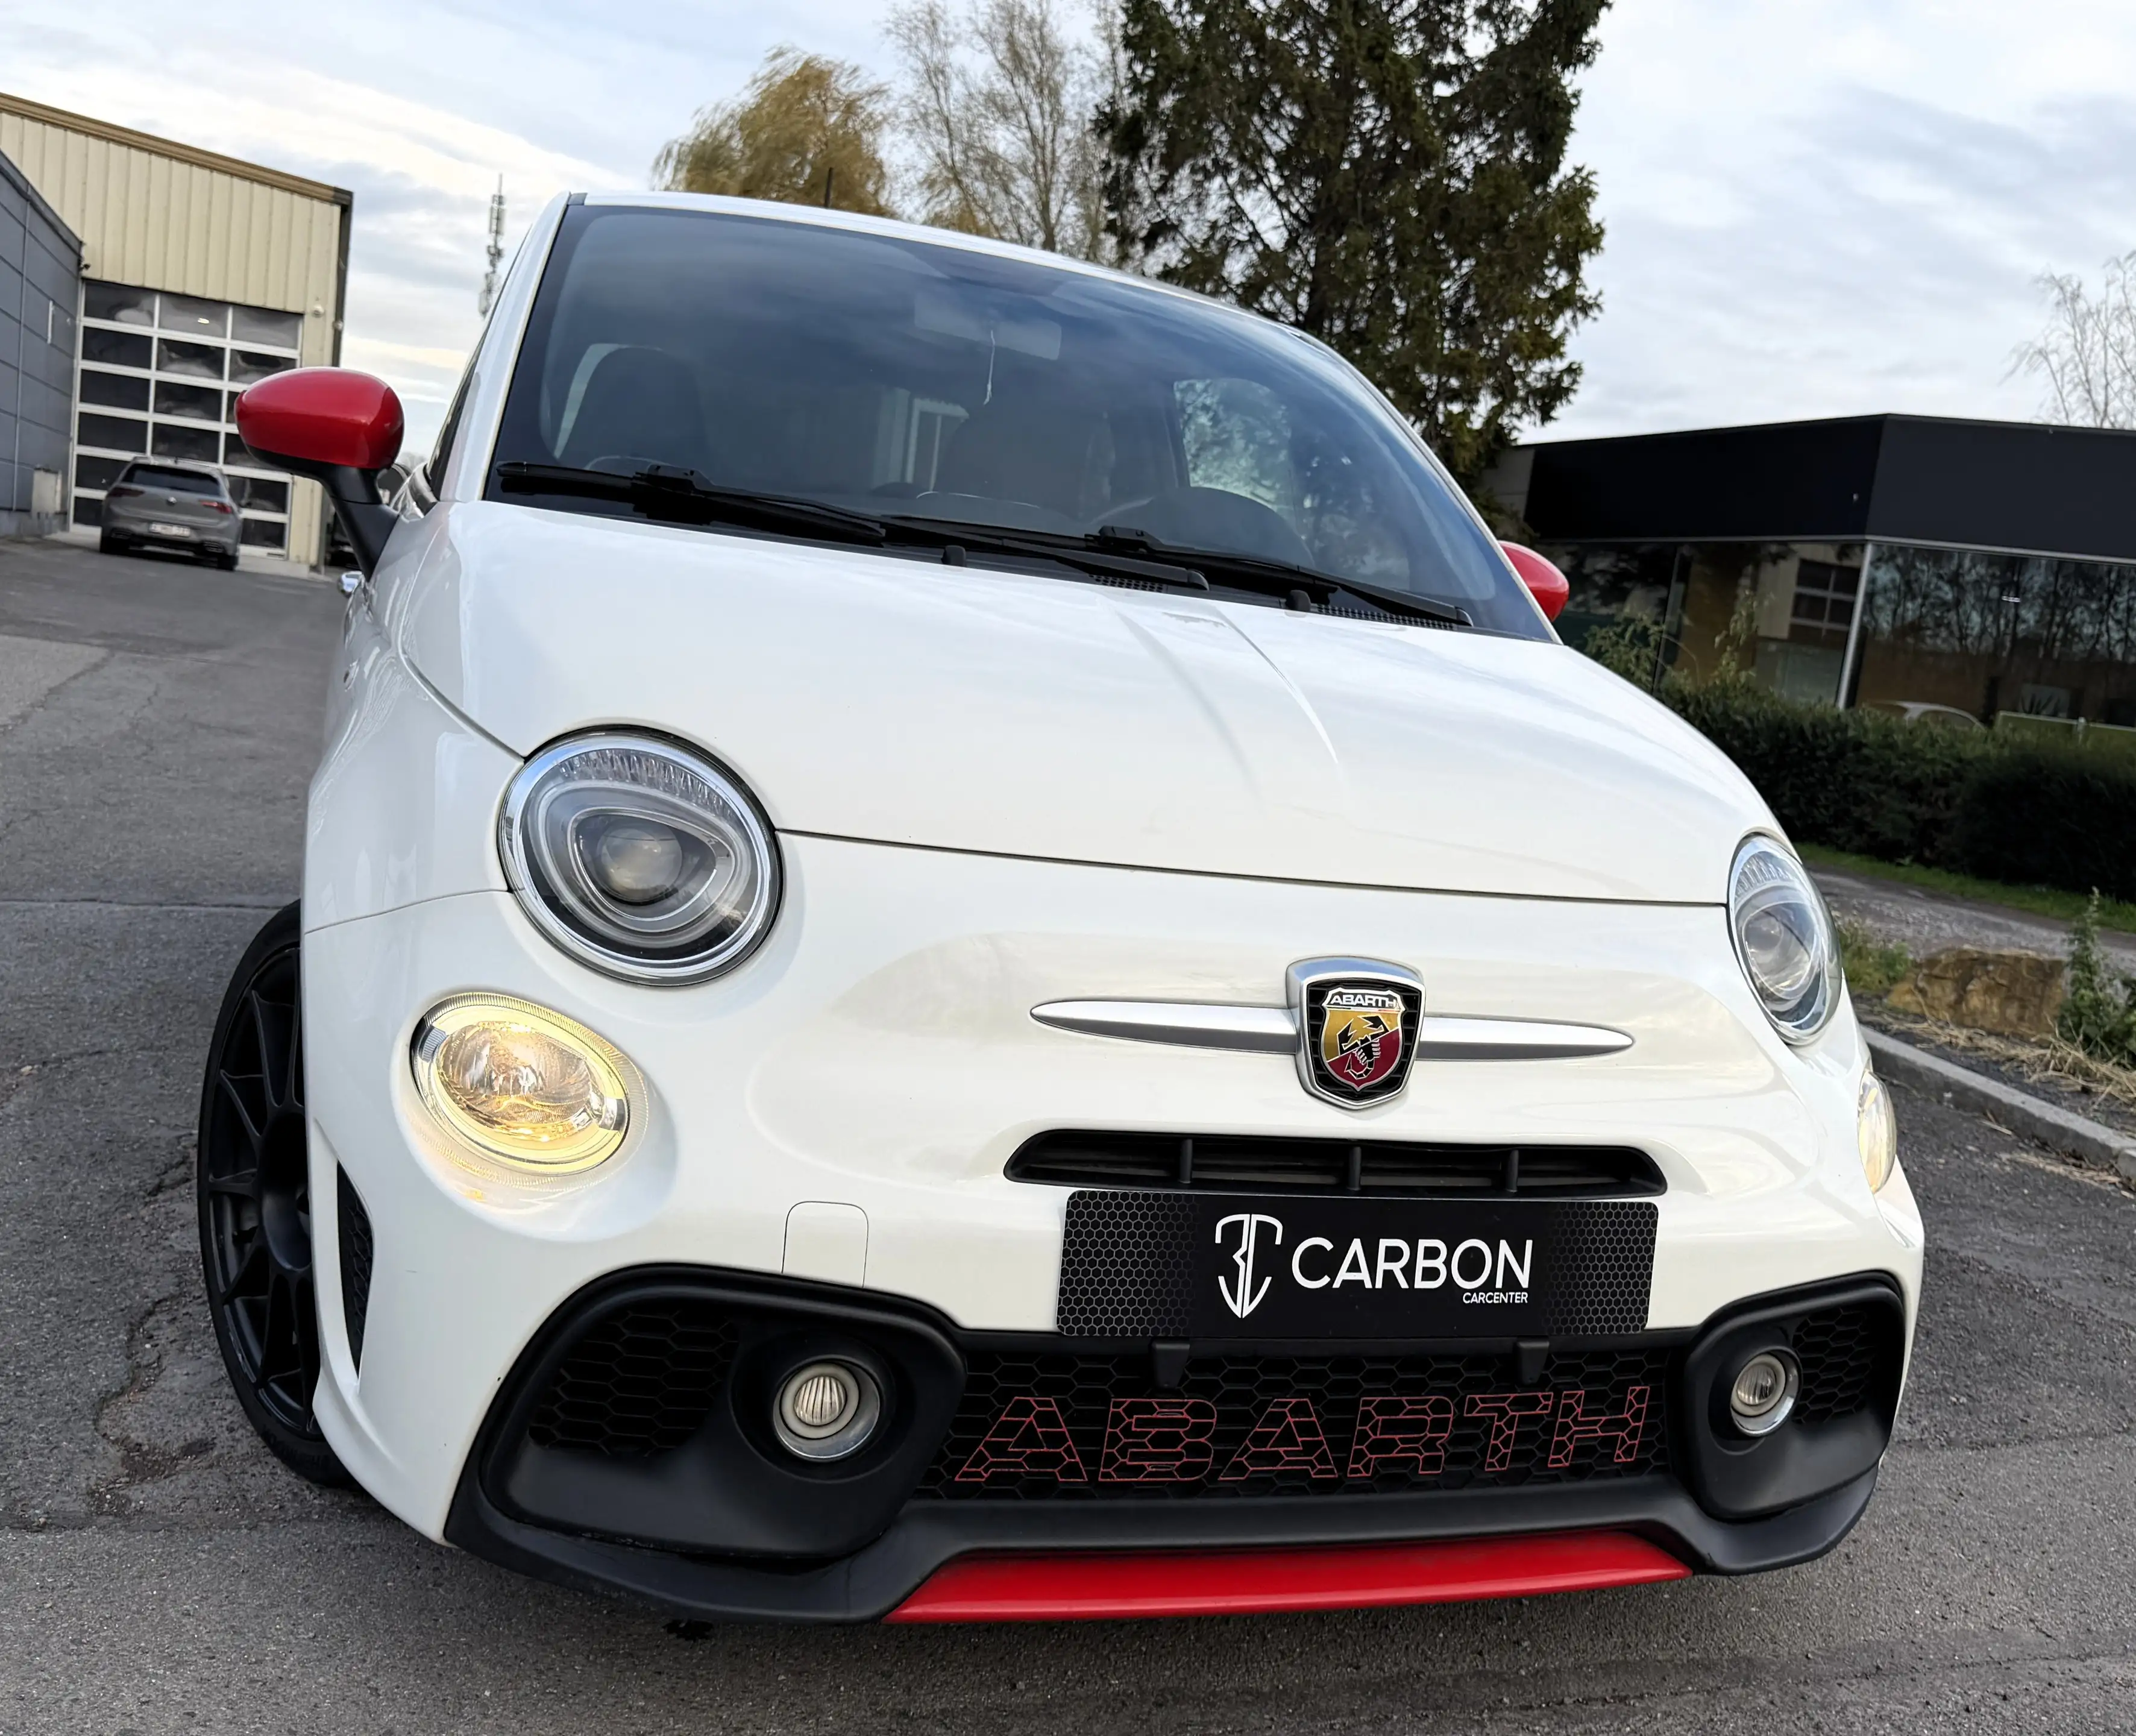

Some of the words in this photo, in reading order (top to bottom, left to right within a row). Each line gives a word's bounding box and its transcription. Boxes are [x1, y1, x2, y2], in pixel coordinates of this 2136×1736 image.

[1330, 993, 1396, 1007] ABARTH
[1292, 1237, 1533, 1289] CARBON
[1463, 1291, 1529, 1304] CARCENTER
[954, 1386, 1650, 1482] ABARTH
